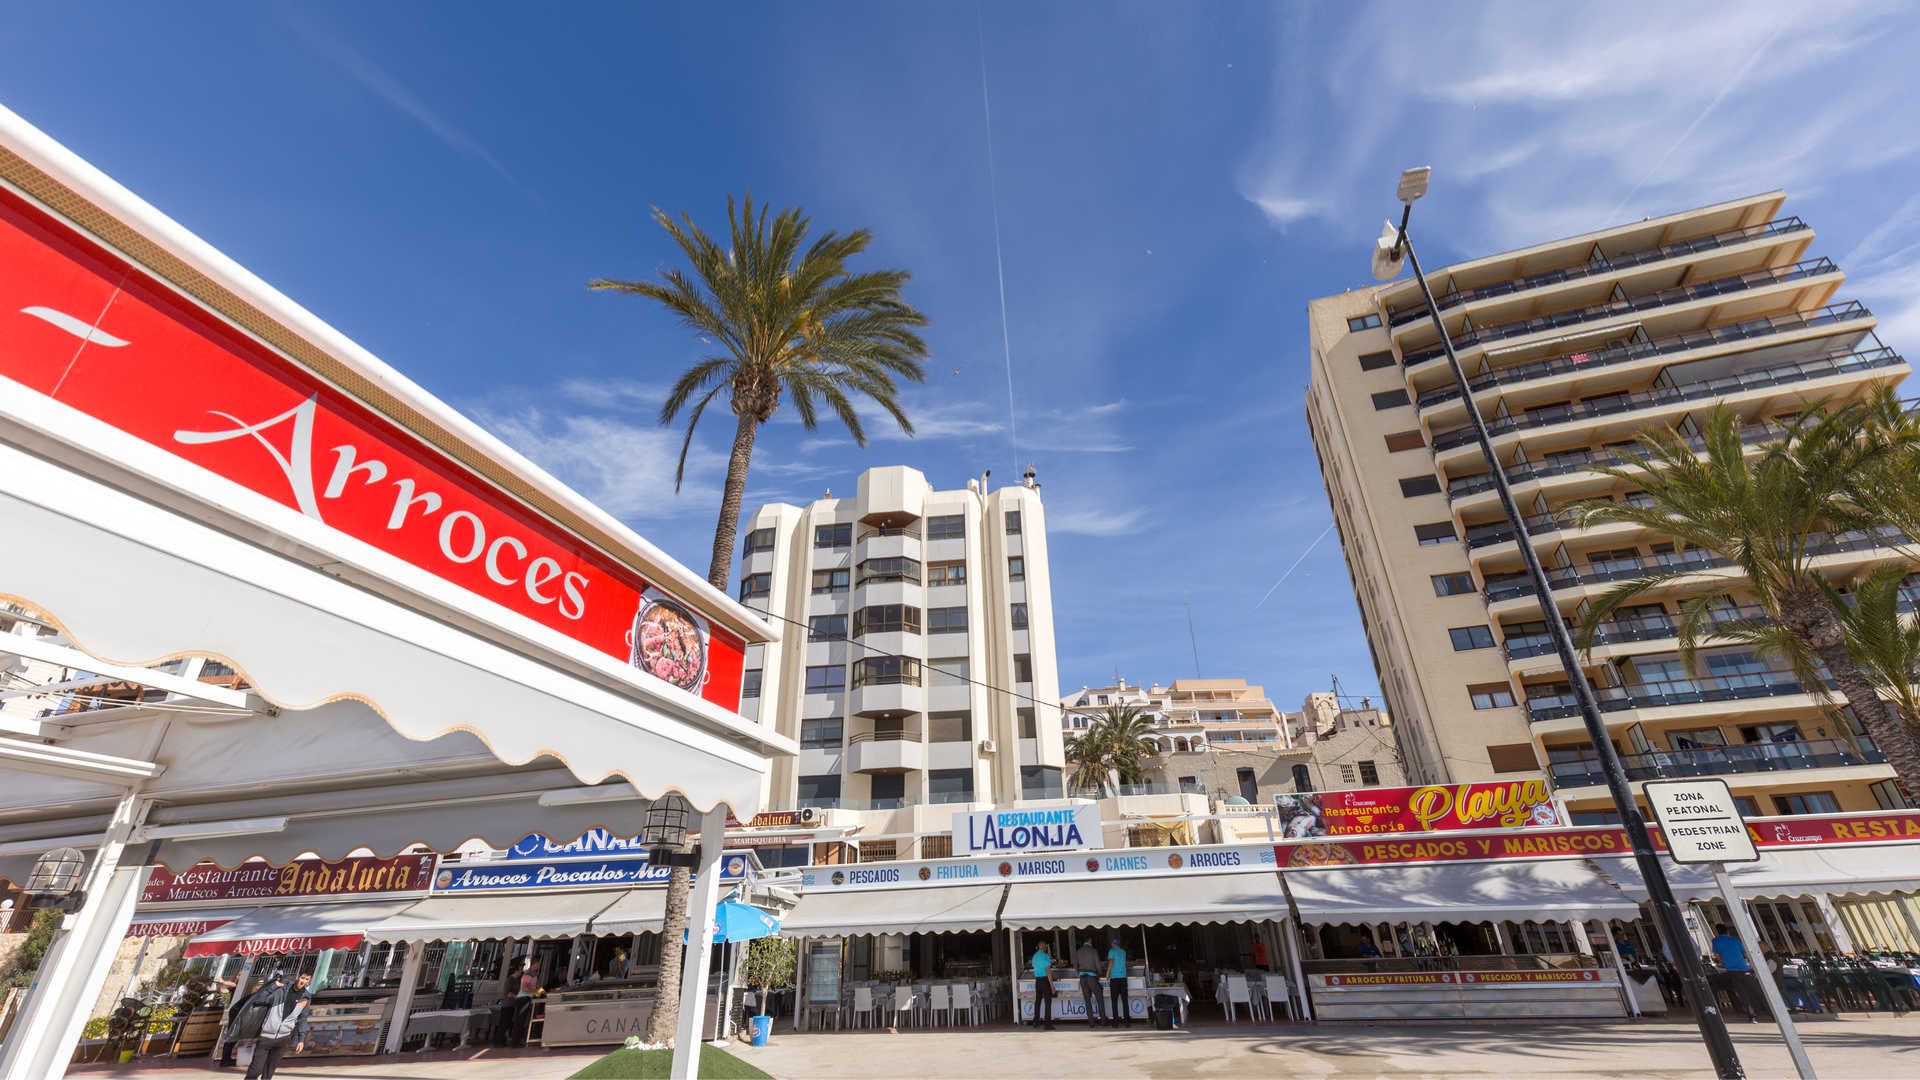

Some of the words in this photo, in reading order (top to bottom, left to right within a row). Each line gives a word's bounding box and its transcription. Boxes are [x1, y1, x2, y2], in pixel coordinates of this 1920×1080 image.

[173, 393, 590, 621] Arroces
[1409, 780, 1550, 832] Playa
[1673, 792, 1705, 802] ZONA
[997, 809, 1075, 827] RESTAURANTE
[1325, 804, 1401, 817] Restaurante
[1666, 804, 1723, 815] PEATONAL
[999, 824, 1084, 849] LONJA
[1671, 825, 1740, 837] PEDESTRIAN
[1363, 841, 1468, 860] PESCADOS
[1478, 839, 1491, 855] Y
[1503, 834, 1615, 853] MARISCOS
[1696, 841, 1726, 851] ZONE
[172, 867, 278, 885] Restaurante
[274, 859, 412, 895] Andalucía
[850, 869, 899, 884] PESCADOS
[937, 864, 979, 879] FRITURA
[1018, 860, 1065, 875] MARISCO
[1106, 856, 1148, 871] CARNES
[1190, 852, 1241, 867] ARROCES
[452, 869, 531, 887] Arroces
[167, 886, 219, 900] Mariscos
[225, 885, 273, 897] Arroces
